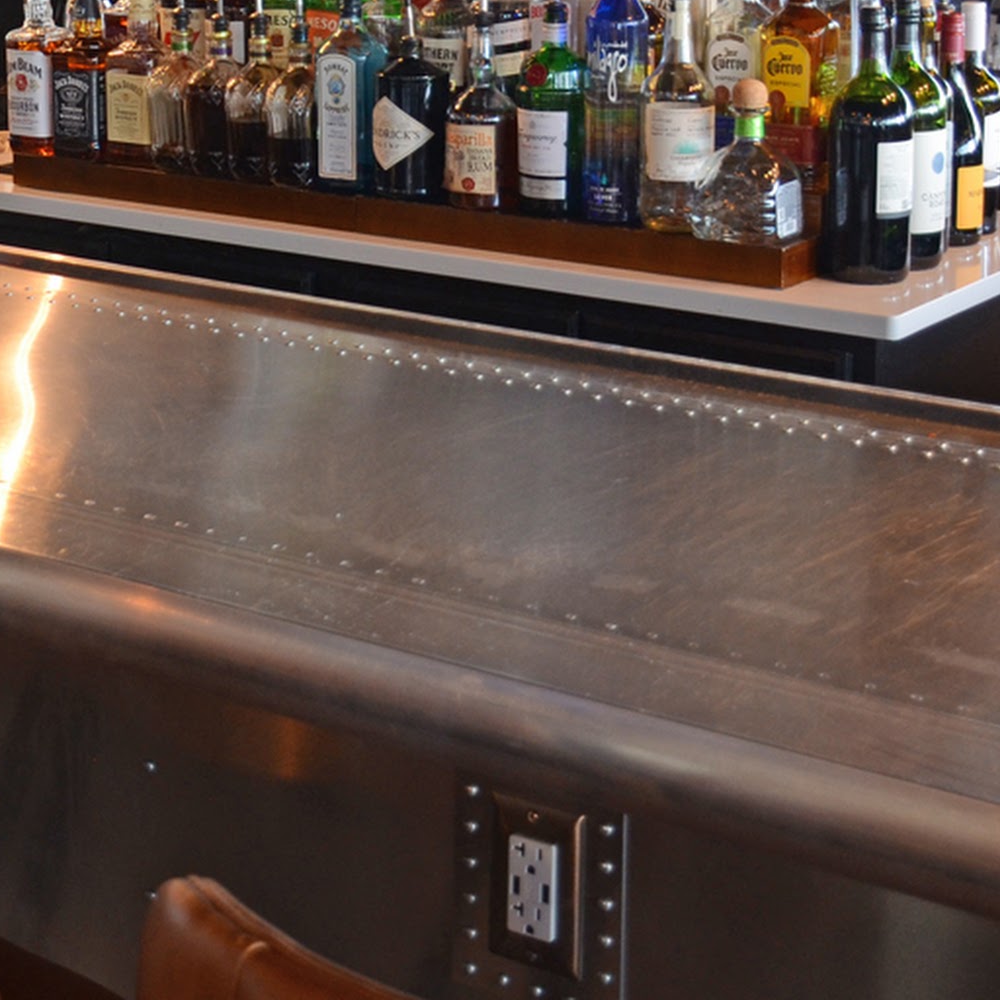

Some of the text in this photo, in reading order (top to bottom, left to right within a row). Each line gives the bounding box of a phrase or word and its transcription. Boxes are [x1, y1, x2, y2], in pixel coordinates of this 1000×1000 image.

[16, 57, 42, 79] BEAM
[711, 53, 749, 72] Cuervo
[766, 57, 804, 77] Cuervo
[467, 161, 493, 173] RUM
